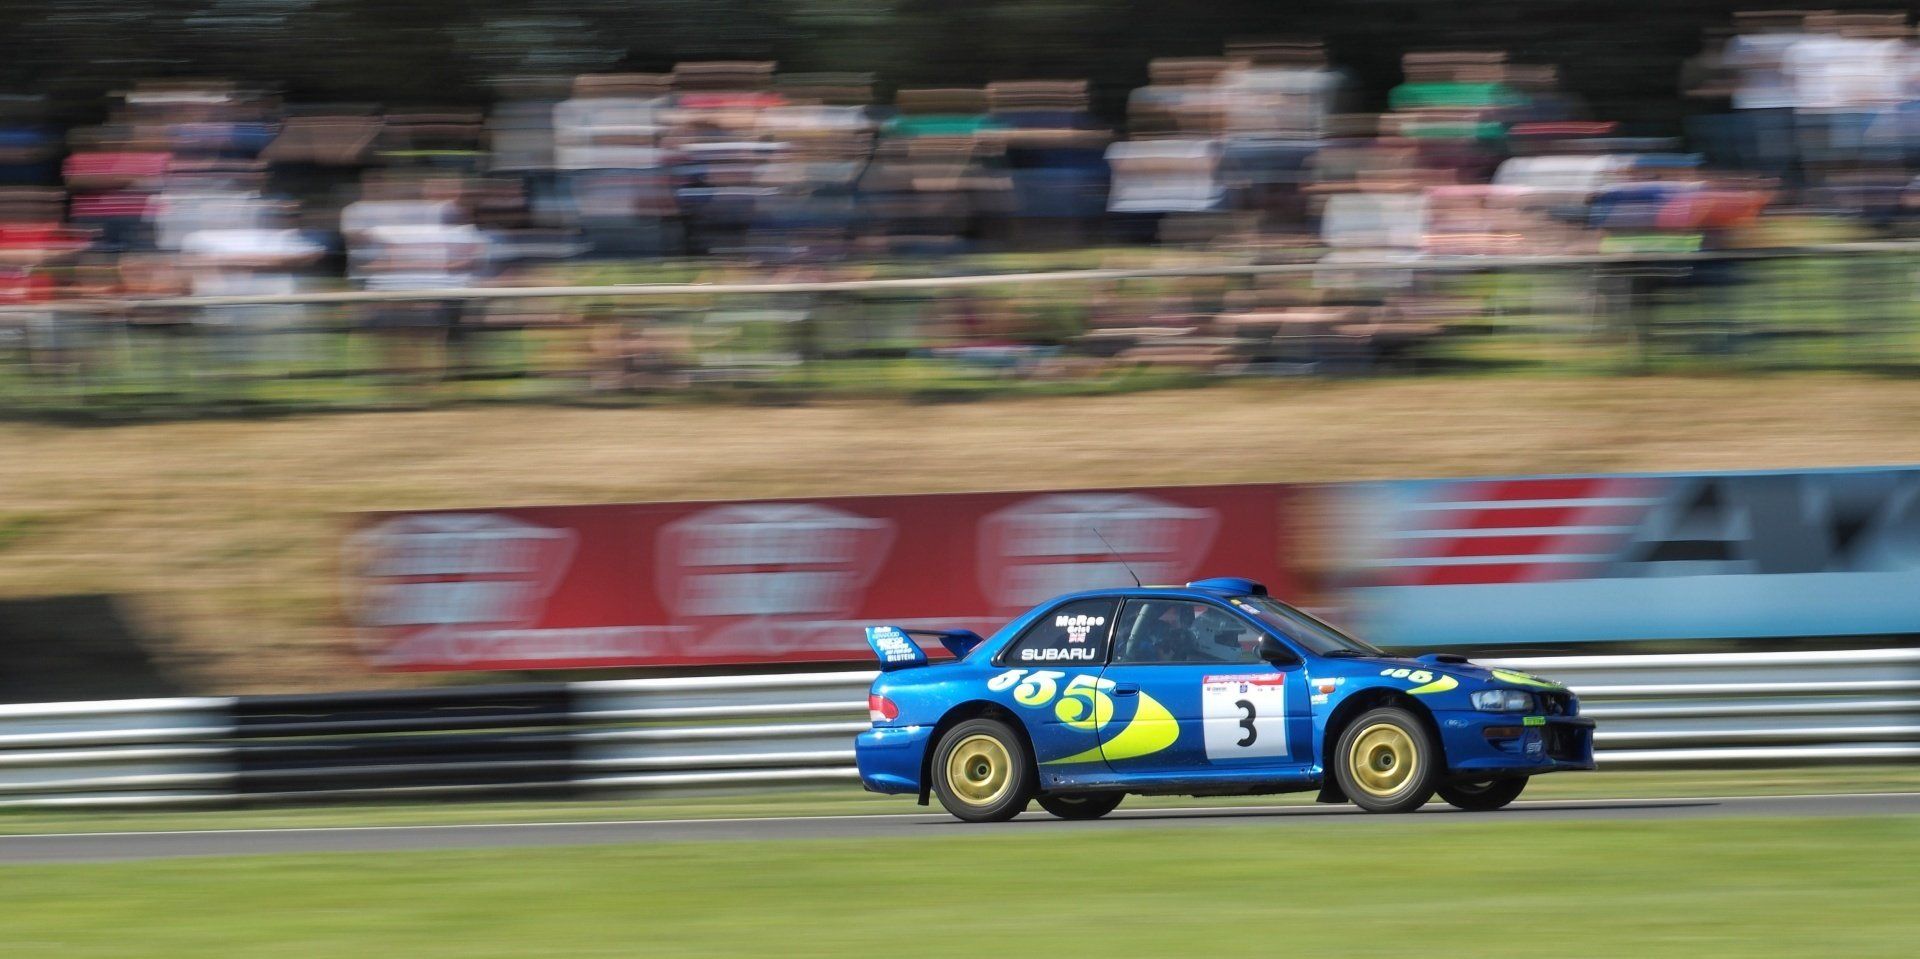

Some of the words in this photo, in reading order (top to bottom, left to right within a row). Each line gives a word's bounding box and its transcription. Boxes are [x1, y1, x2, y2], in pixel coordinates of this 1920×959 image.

[1055, 614, 1105, 627] McRae
[1021, 647, 1096, 660] SUBARU
[1234, 699, 1258, 748] 3
